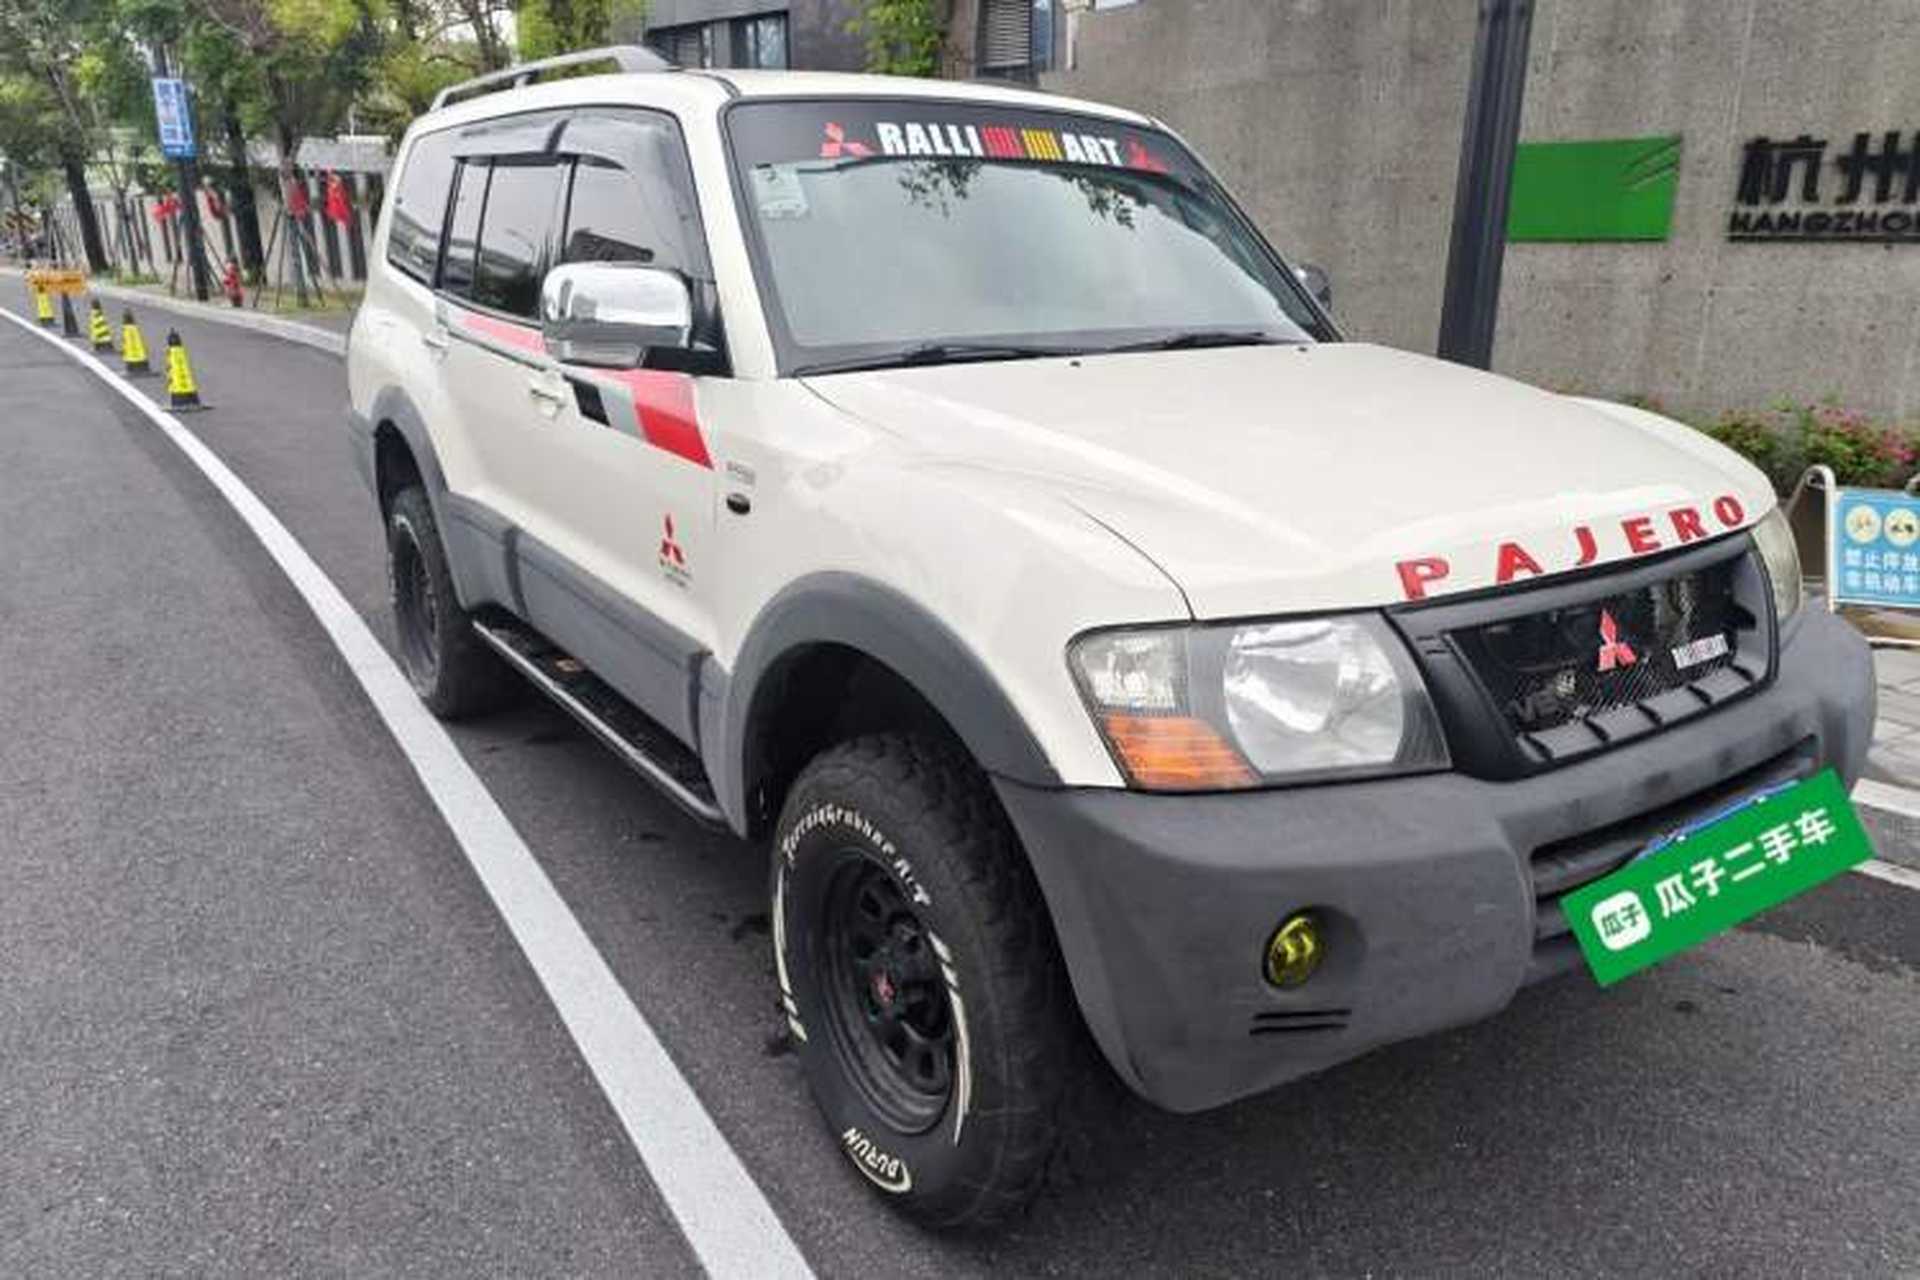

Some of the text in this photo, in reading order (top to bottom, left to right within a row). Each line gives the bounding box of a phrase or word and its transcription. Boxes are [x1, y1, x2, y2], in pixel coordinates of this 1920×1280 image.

[1729, 211, 1920, 233] HANGZHO
[1396, 496, 1745, 600] PAJERO
[842, 1127, 900, 1178] DURUN
